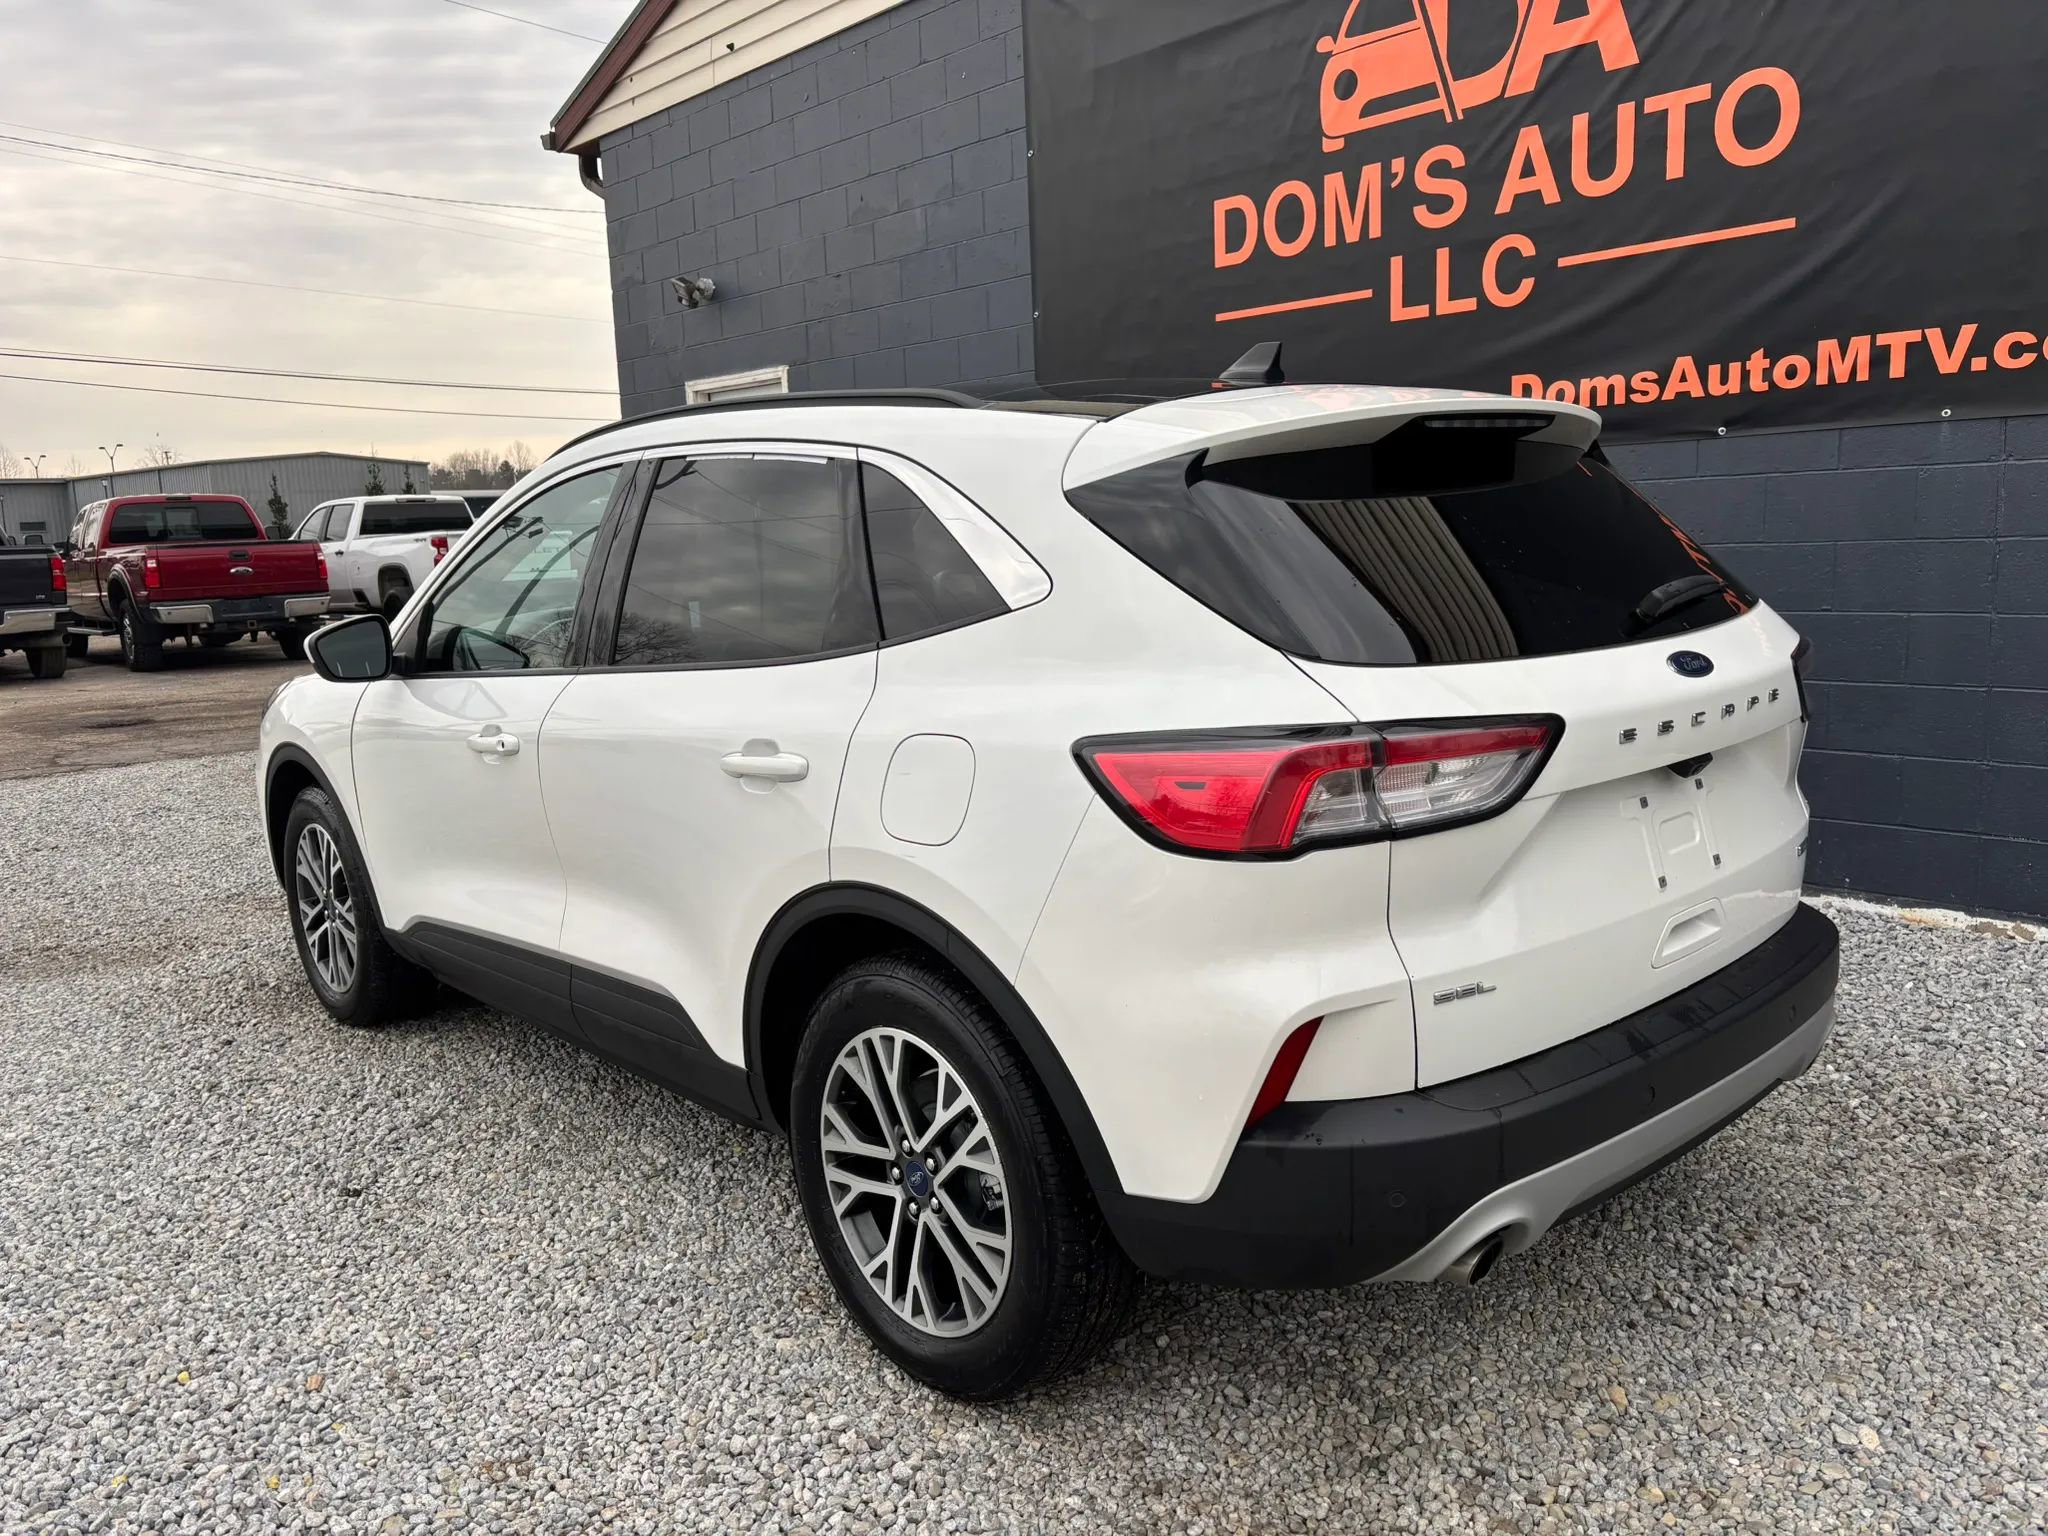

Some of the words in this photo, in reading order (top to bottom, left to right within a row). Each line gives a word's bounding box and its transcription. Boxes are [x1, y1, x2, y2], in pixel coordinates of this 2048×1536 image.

[1214, 144, 1468, 269] DOM'S
[1495, 67, 1801, 215] AUTO
[1390, 233, 1536, 322] LLC
[1511, 323, 2048, 409] DomsAutoMTV.c
[1619, 688, 1779, 744] ESCAPE
[1433, 981, 1497, 1006] SEL
